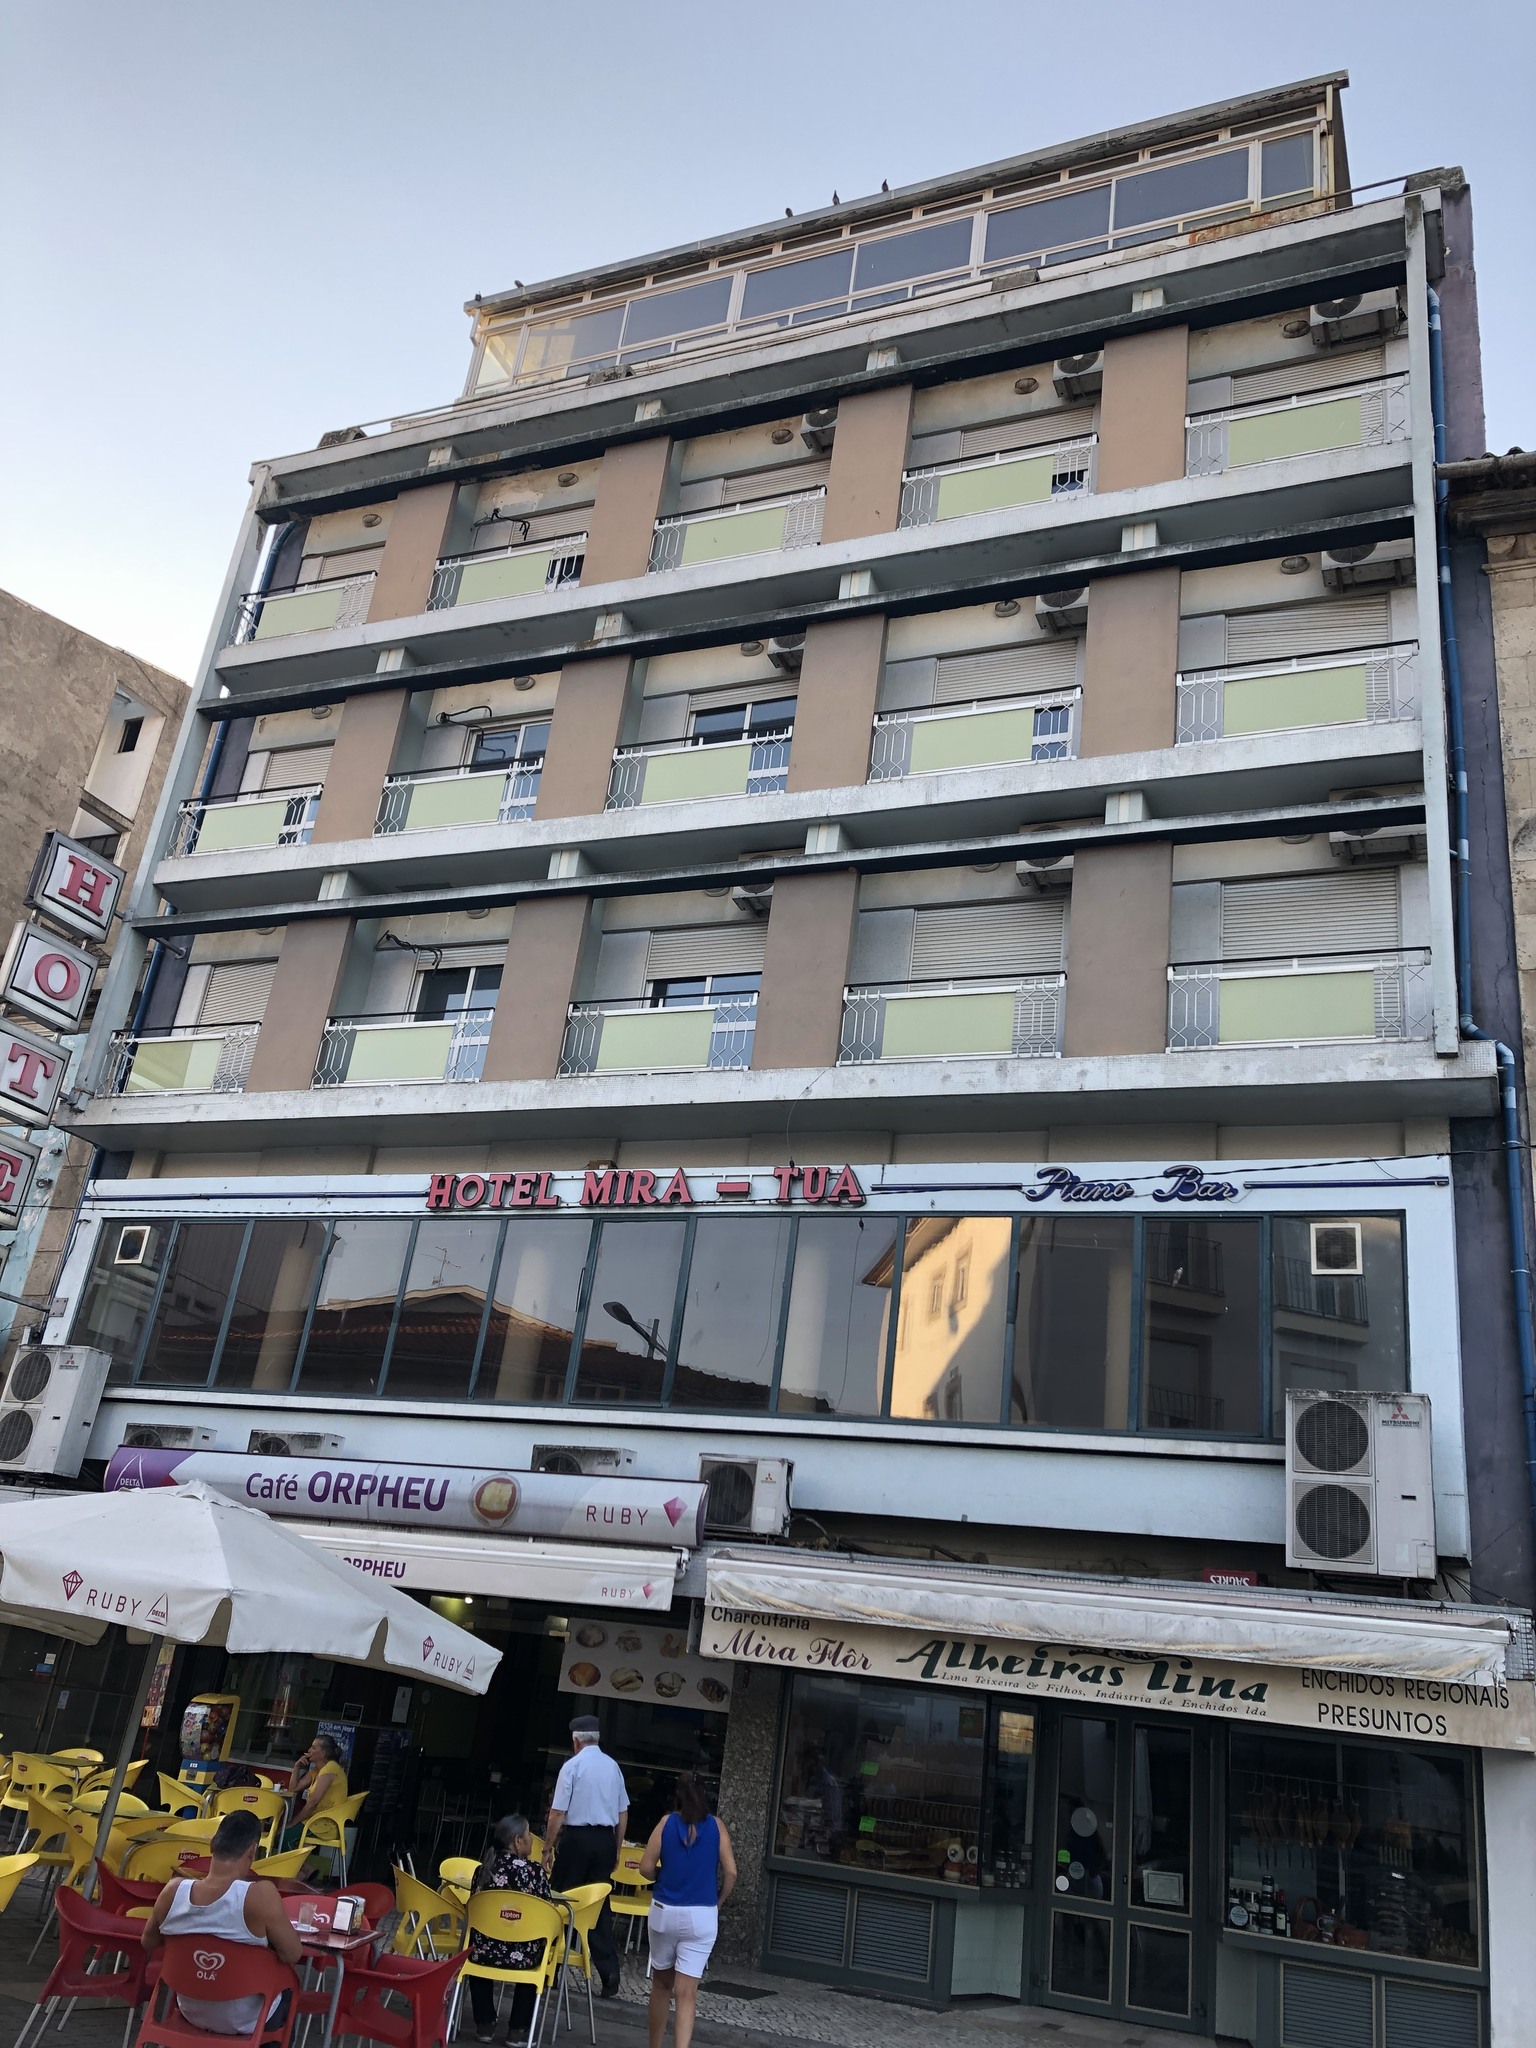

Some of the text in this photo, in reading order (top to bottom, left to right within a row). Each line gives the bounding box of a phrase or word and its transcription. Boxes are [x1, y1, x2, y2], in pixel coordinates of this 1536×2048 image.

[425, 1171, 559, 1209] HOTEL
[580, 1166, 693, 1206] MIRA
[774, 1163, 866, 1205] TUA
[1025, 1164, 1239, 1202] Piano Bar
[120, 1477, 140, 1487] DELTA
[246, 1470, 450, 1512] Café ORPHEU
[586, 1504, 649, 1526] RUBY
[86, 1588, 142, 1617] RUBY
[601, 1587, 635, 1599] RUBY
[711, 1606, 811, 1631] Charcutaria
[433, 1651, 463, 1674] RUBY
[712, 1628, 873, 1671] Mira Flôr
[895, 1639, 1126, 1687] Alheiras
[941, 1672, 968, 1683] Lina
[975, 1675, 1020, 1689] Teixeira
[1026, 1682, 1040, 1690] &
[1046, 1684, 1087, 1698] Filhos,
[1095, 1689, 1152, 1704] Indústria
[1159, 1697, 1174, 1707] de
[1181, 1699, 1238, 1714] Enchidos
[1301, 1668, 1510, 1710] ENCHIDOS REGIONAIS
[1318, 1702, 1448, 1737] PRESUNTOS
